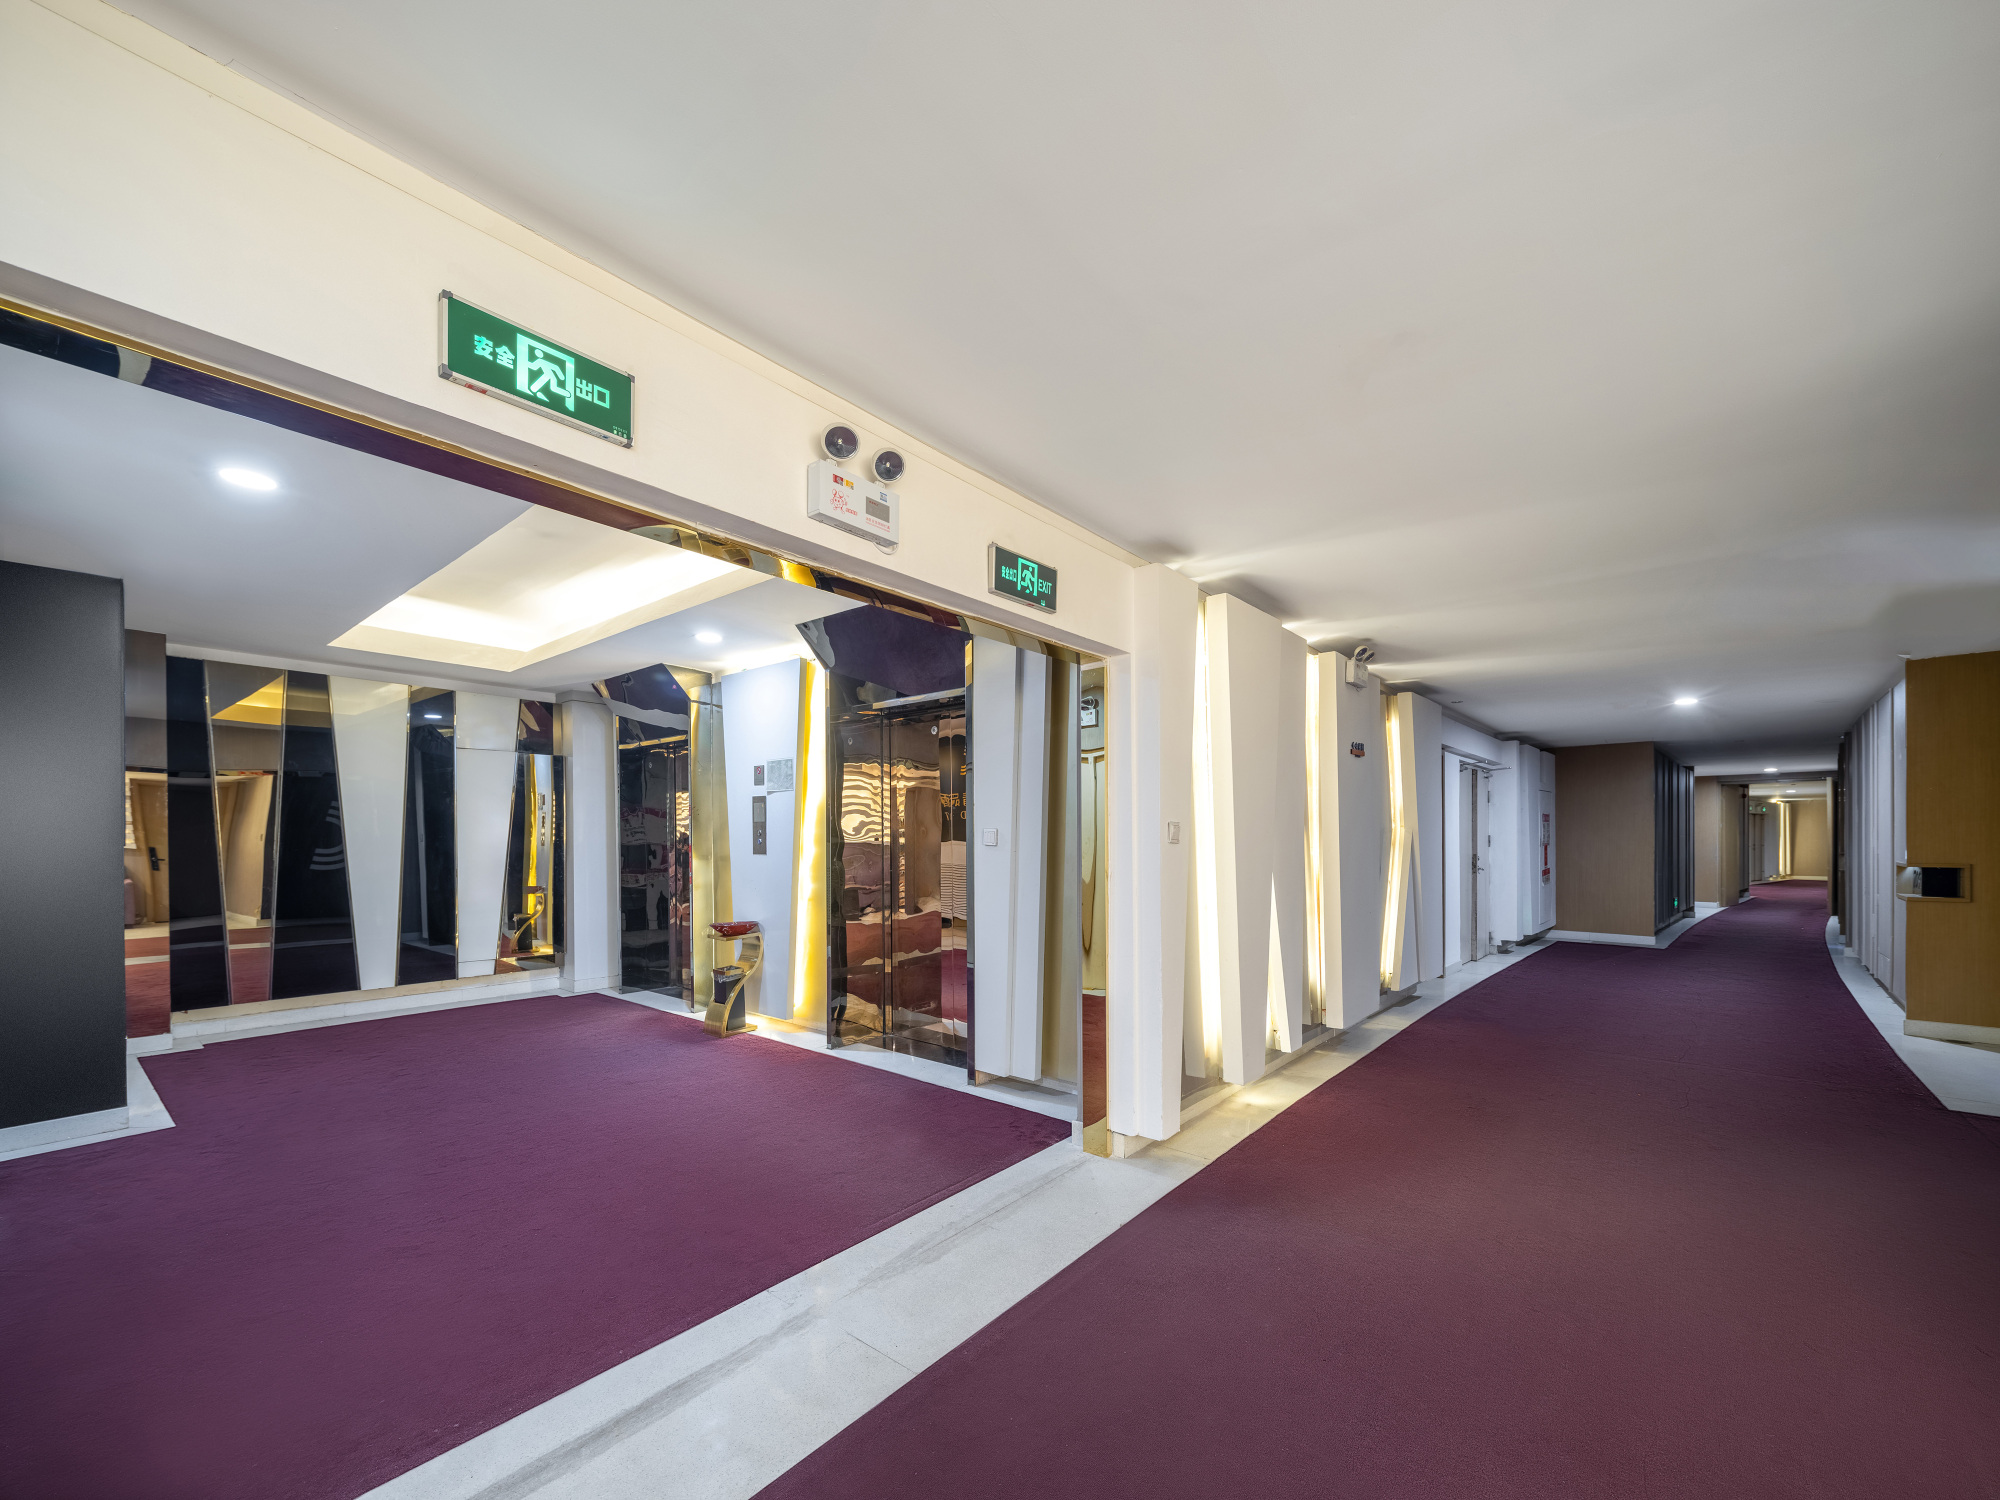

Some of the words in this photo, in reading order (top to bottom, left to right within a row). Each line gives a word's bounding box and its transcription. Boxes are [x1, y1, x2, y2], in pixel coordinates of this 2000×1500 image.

[474, 334, 515, 369] 安全
[575, 378, 610, 409] 出口
[1038, 578, 1052, 594] EXIT
